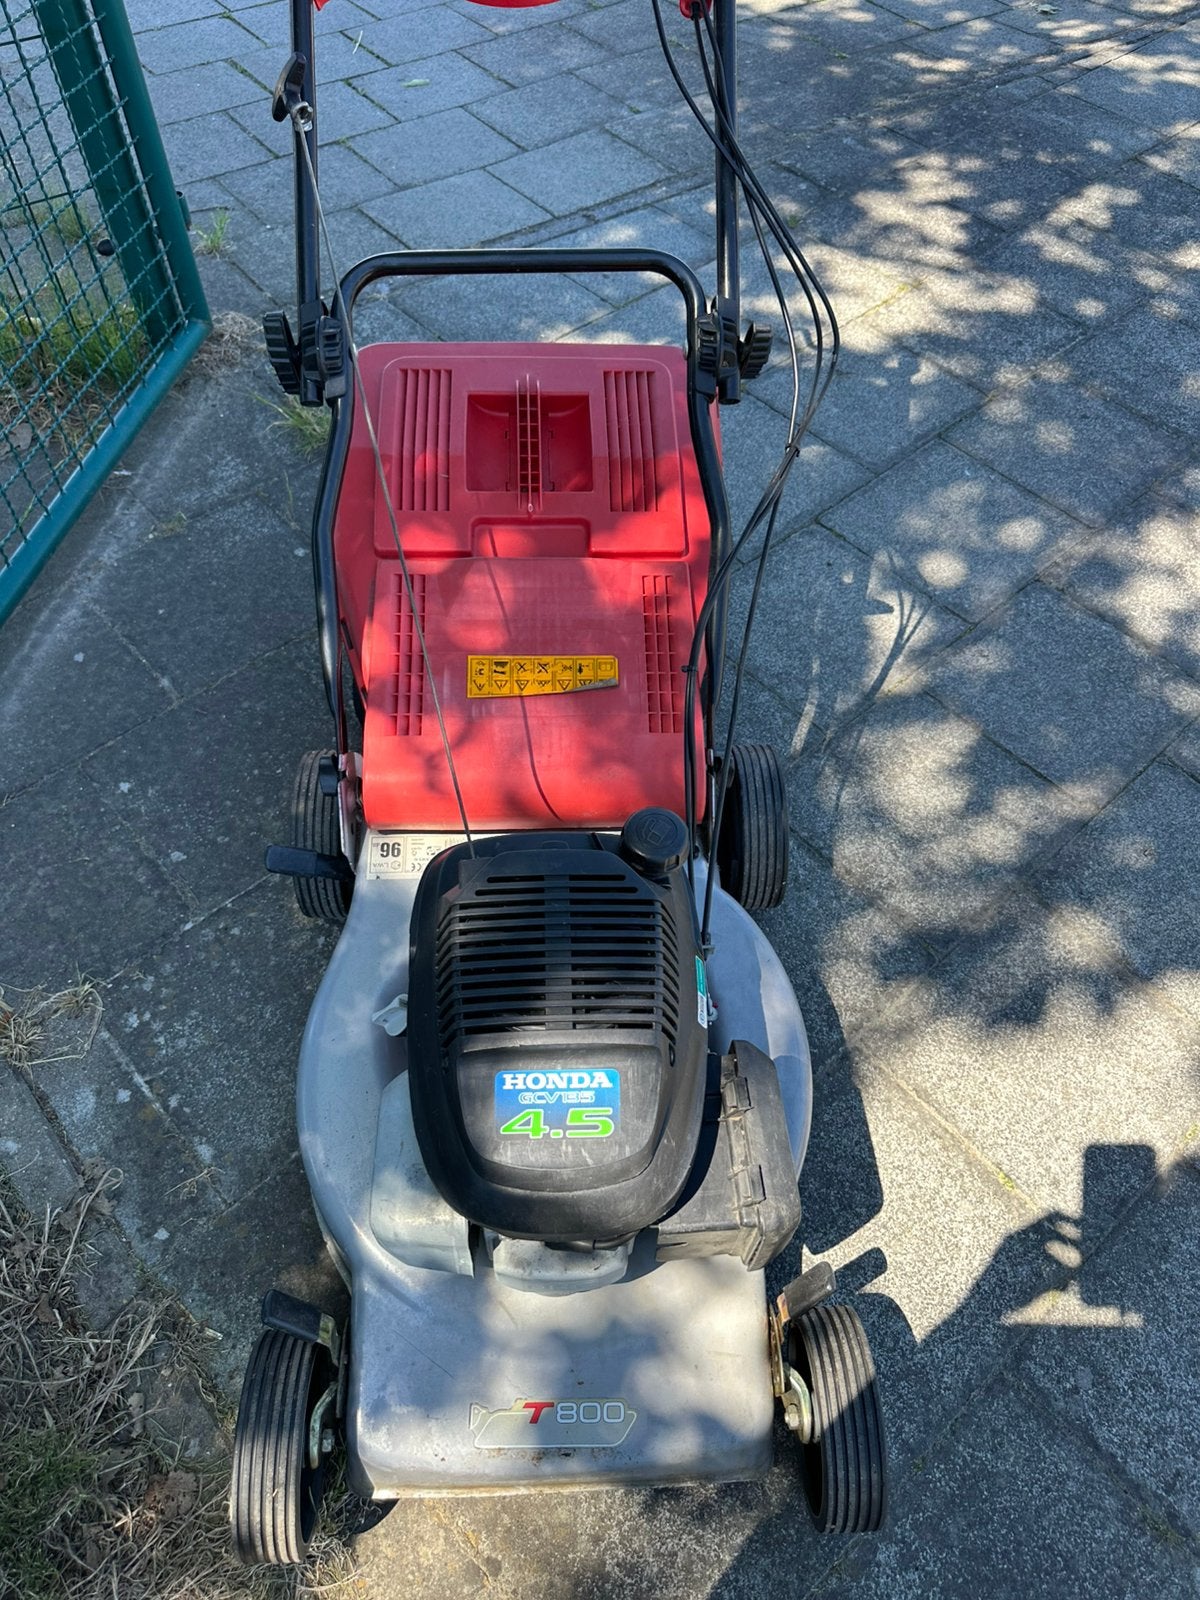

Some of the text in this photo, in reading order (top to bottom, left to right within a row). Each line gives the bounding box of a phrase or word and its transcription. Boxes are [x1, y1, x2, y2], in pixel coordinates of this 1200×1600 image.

[380, 842, 401, 858] 96
[503, 1072, 613, 1090] HONDA
[518, 1091, 595, 1104] GCV135
[500, 1107, 614, 1139] 4.5
[523, 1402, 625, 1424] T800
